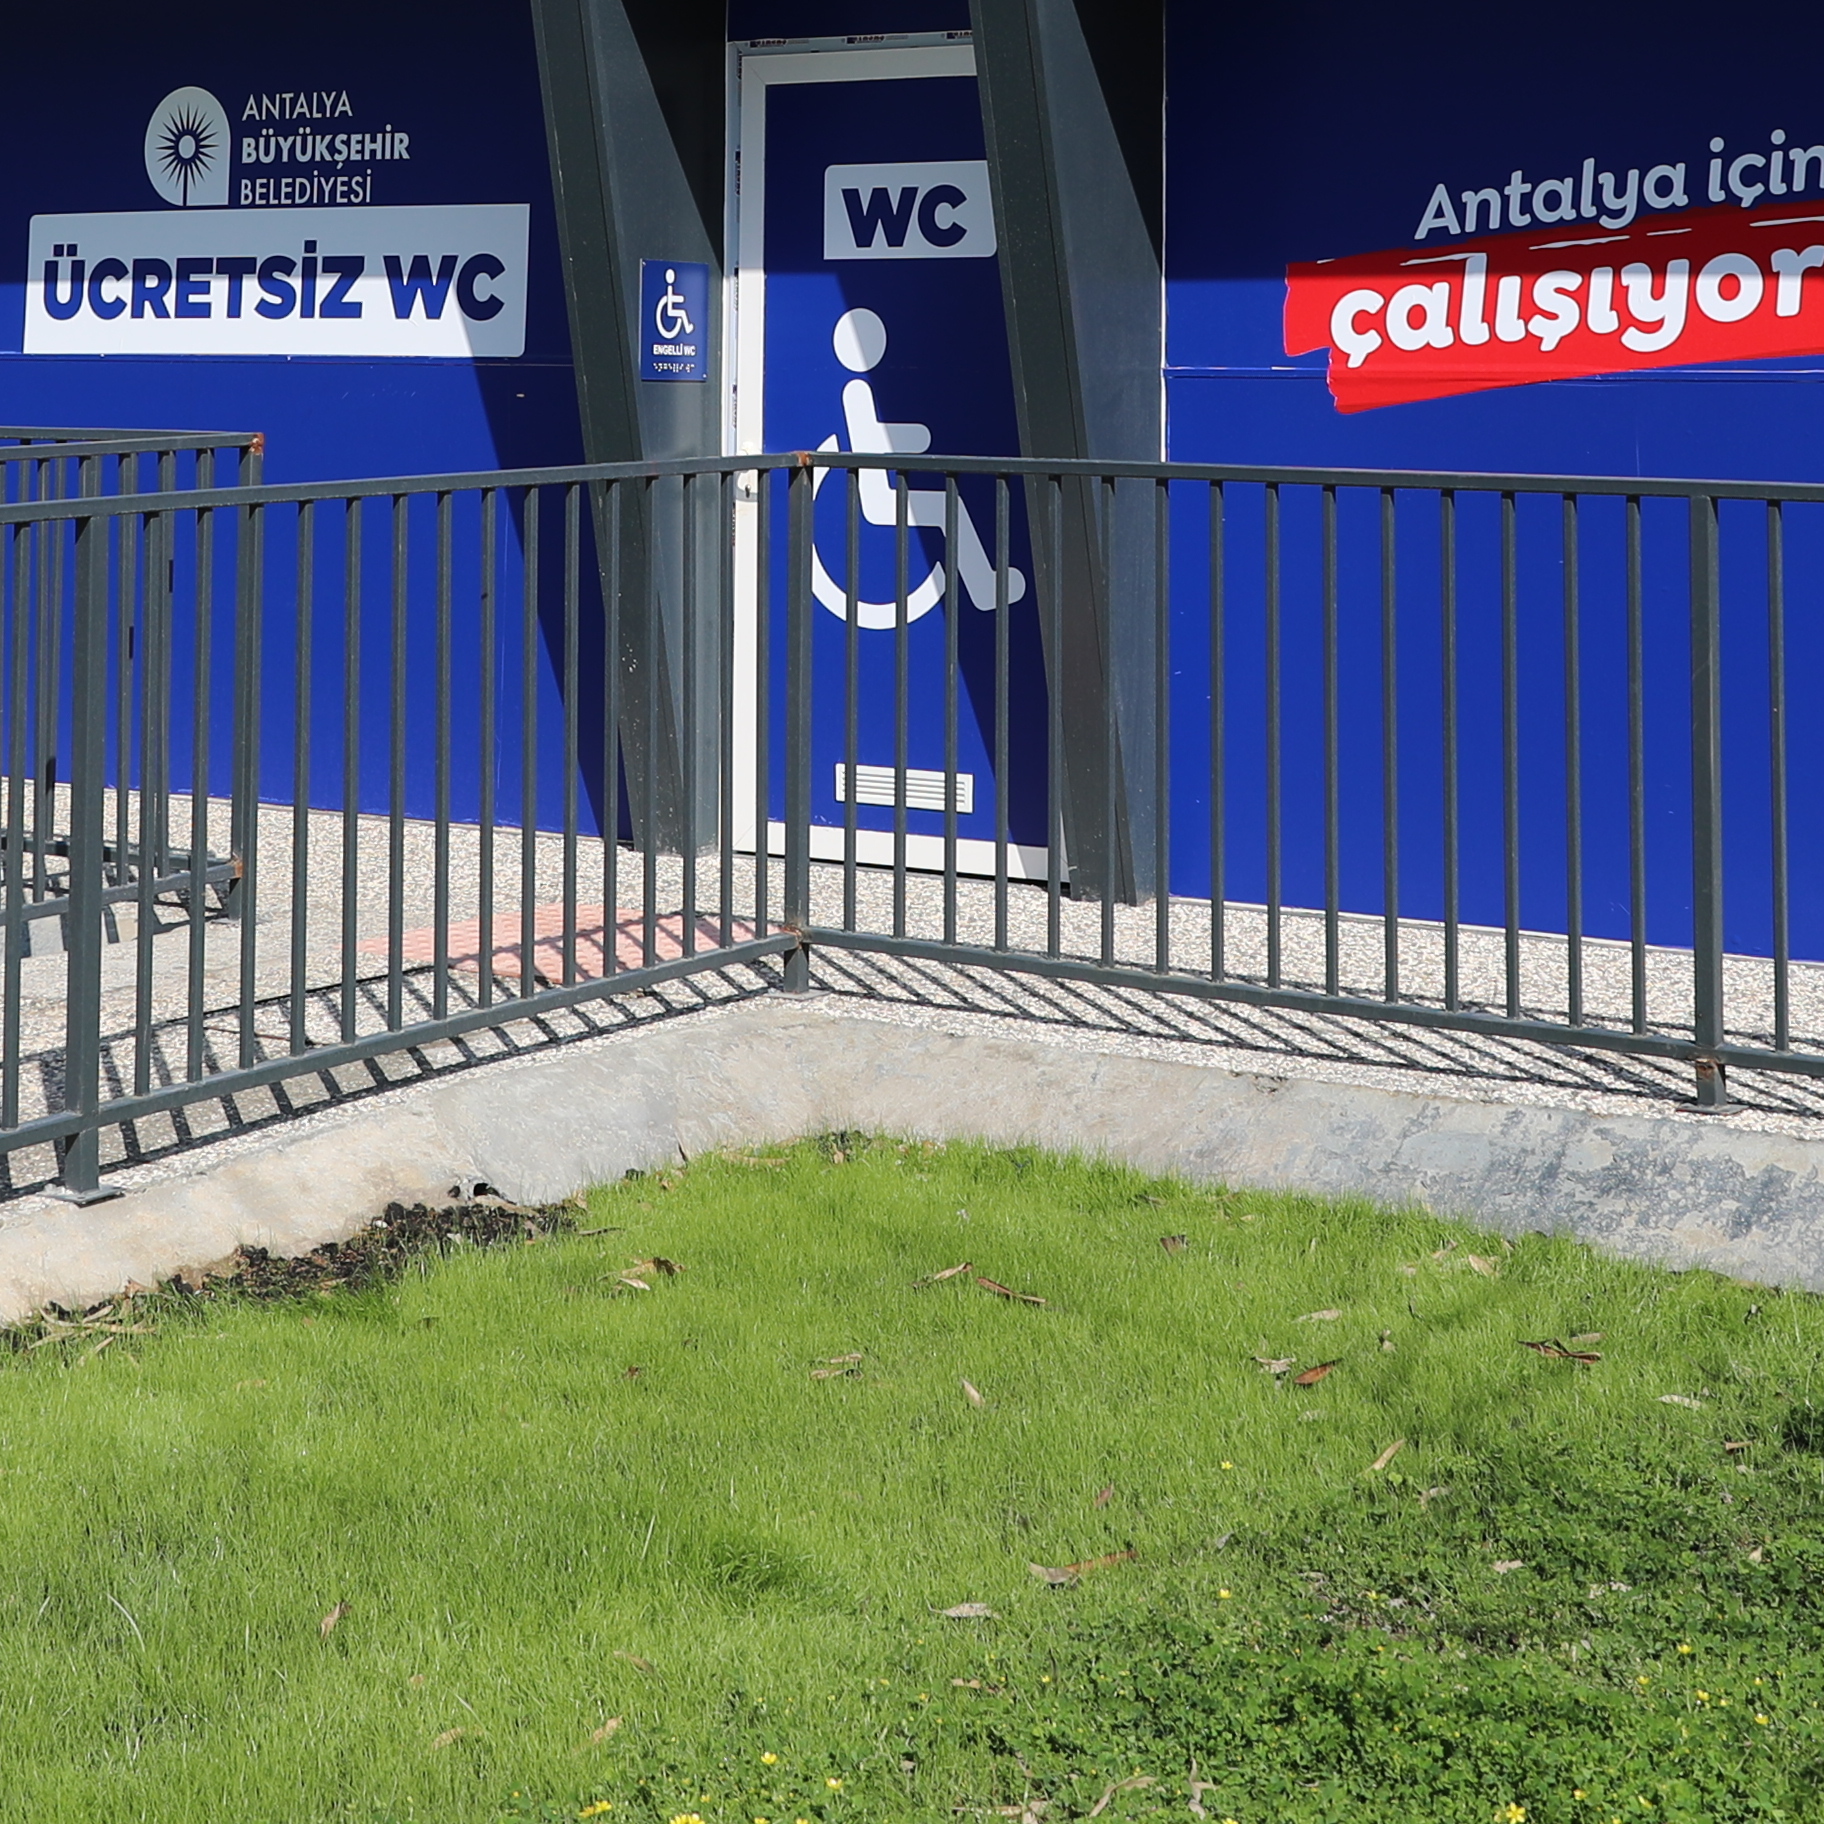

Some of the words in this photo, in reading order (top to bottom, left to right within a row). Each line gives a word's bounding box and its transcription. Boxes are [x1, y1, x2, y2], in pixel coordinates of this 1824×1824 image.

[241, 90, 354, 121] ANTALYA
[241, 124, 411, 170] BÜYÜKŞEHİR
[240, 168, 372, 205] BELEDİYESİ
[1413, 157, 1690, 240] Antalya
[841, 184, 968, 248] WC
[43, 239, 366, 320] ÜCRETSİZ
[382, 253, 506, 322] WC
[684, 345, 696, 356] WC
